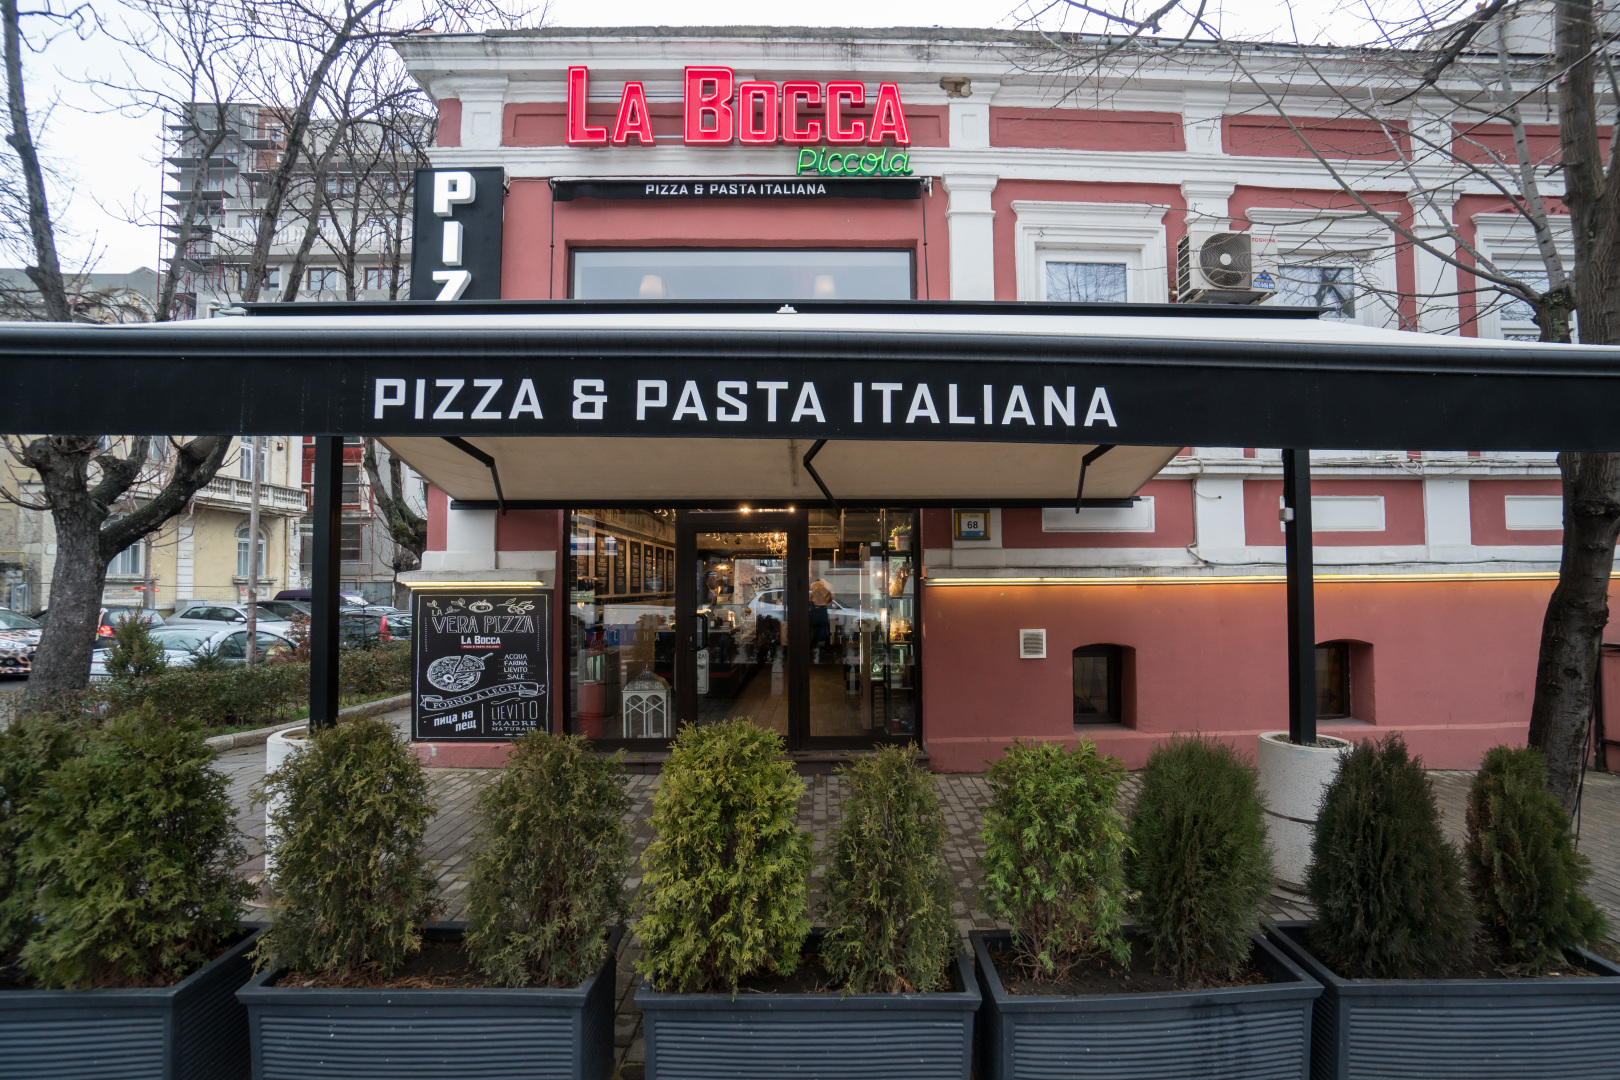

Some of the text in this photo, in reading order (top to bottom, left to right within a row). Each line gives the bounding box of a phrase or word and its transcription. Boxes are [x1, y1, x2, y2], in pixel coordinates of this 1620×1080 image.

[567, 66, 911, 147] LA BOCCA
[796, 147, 914, 178] Piccola
[645, 184, 826, 195] PIZZA & PASTA ITALIANA
[373, 378, 1118, 427] PIZZA & PASTA ITALIANA
[967, 520, 979, 530] 68
[431, 609, 443, 617] LA
[432, 615, 535, 634] VERA PIZZA
[461, 635, 502, 645] LA BOCCA
[433, 684, 527, 709] FORNO A LEGNA
[433, 710, 474, 727] пица на
[491, 700, 538, 720] LIEVITO
[455, 720, 477, 732] пещ
